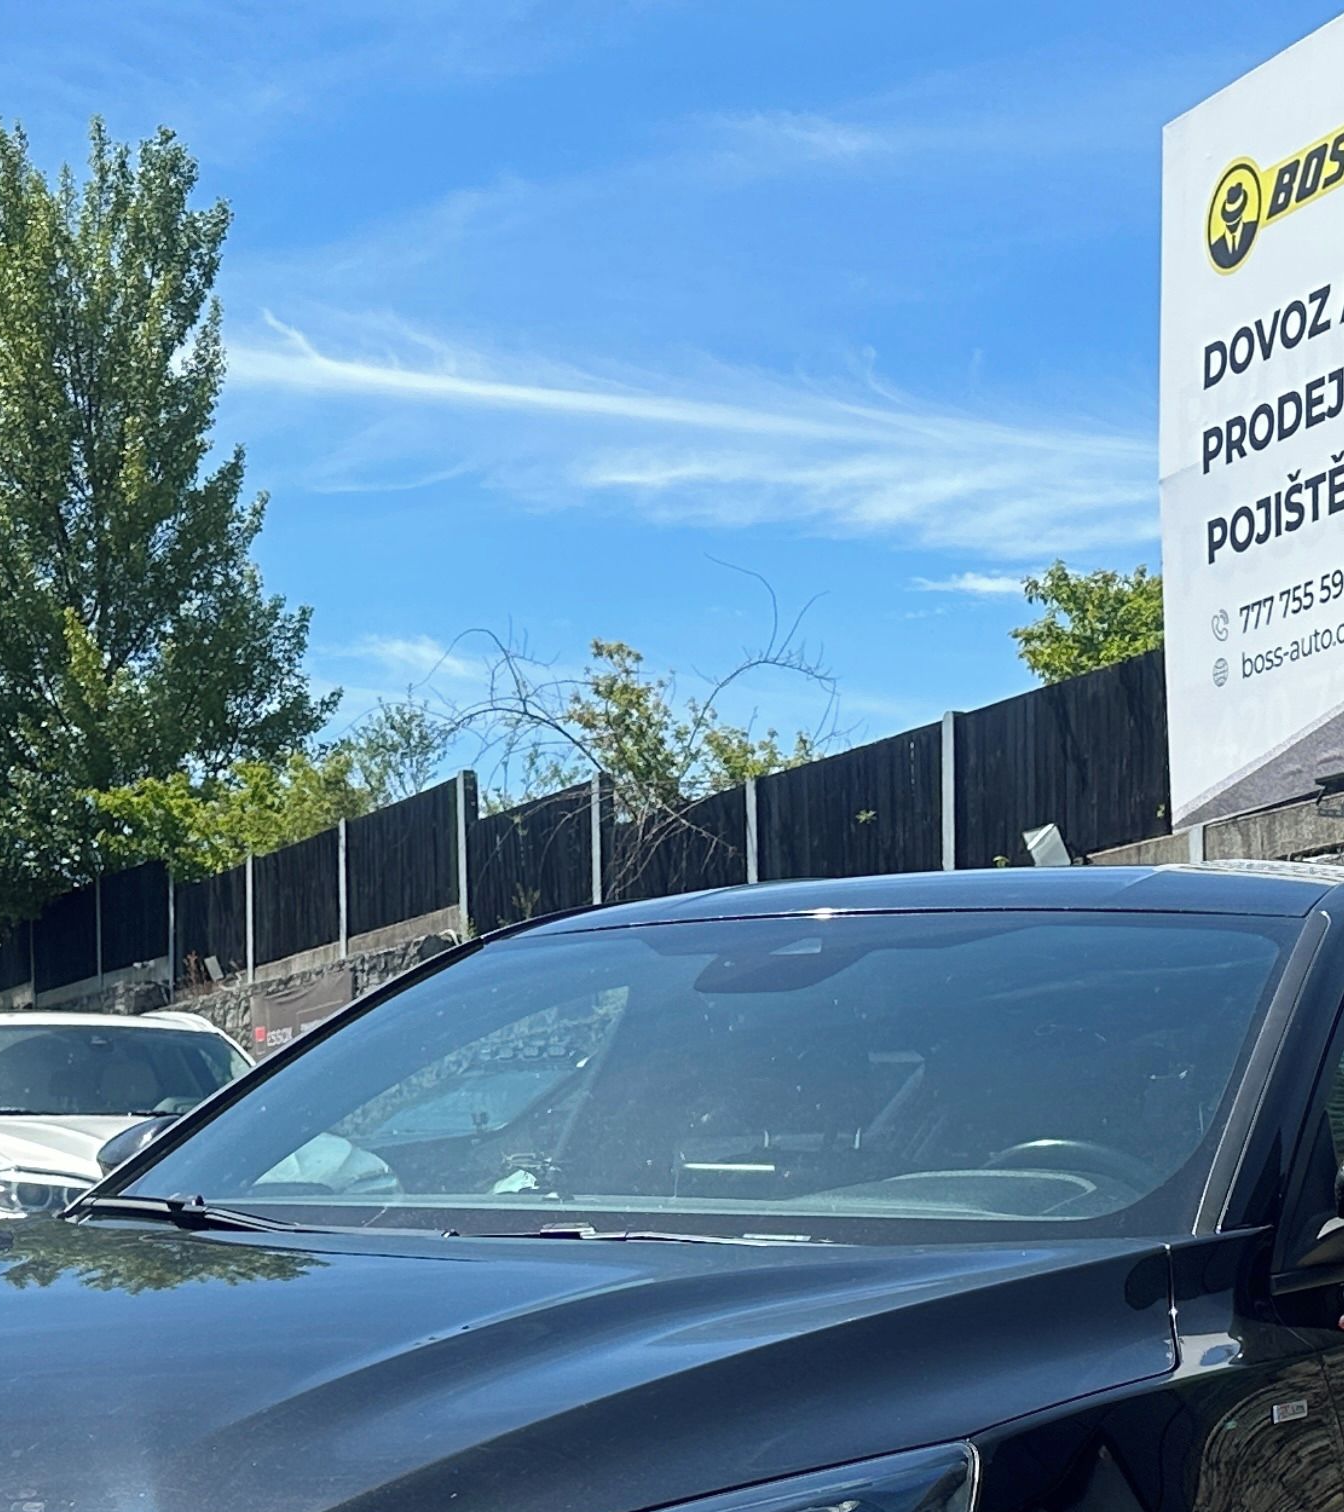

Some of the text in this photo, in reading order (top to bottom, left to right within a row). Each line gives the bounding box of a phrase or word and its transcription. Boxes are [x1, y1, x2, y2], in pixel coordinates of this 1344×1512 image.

[1201, 286, 1331, 390] DOVOZ
[1201, 375, 1344, 474] PRODEJ
[1239, 592, 1276, 634] 777
[1280, 578, 1317, 620] 755
